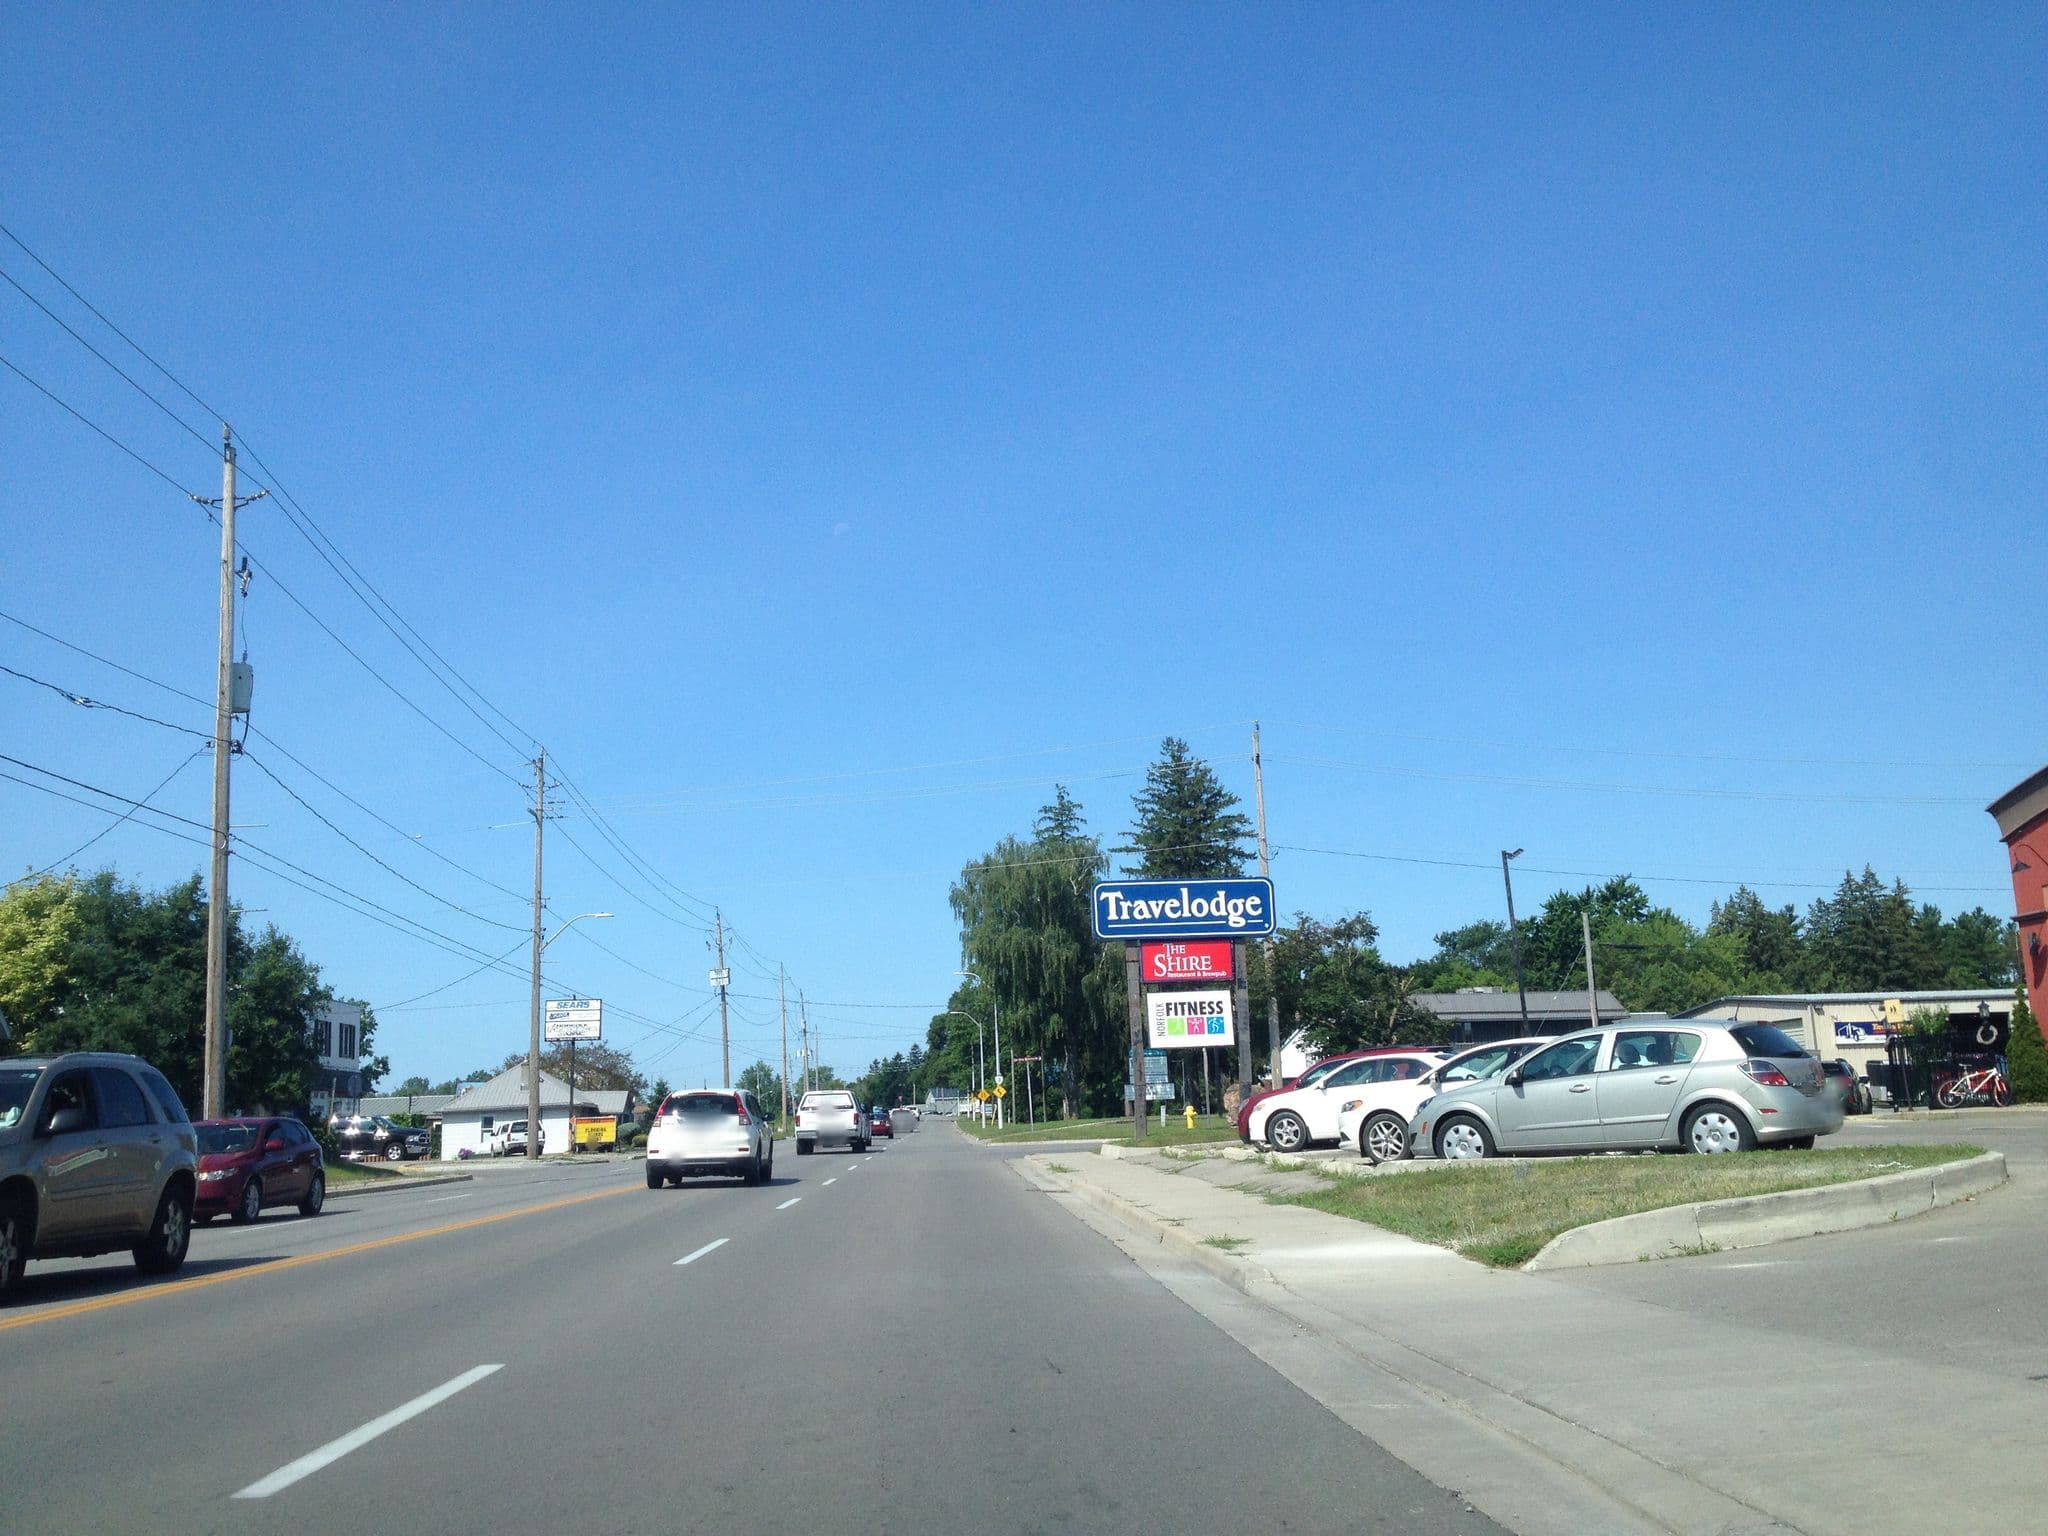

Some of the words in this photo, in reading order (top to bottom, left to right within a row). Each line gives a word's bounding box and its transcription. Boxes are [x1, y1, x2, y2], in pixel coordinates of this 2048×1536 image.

[1099, 888, 1262, 928] Travelodge
[1163, 943, 1186, 957] THE
[1154, 953, 1212, 977] SHIRE
[556, 1001, 590, 1009] SEARS
[1165, 1001, 1224, 1017] FITNESS
[1155, 1002, 1166, 1037] NORFOLK
